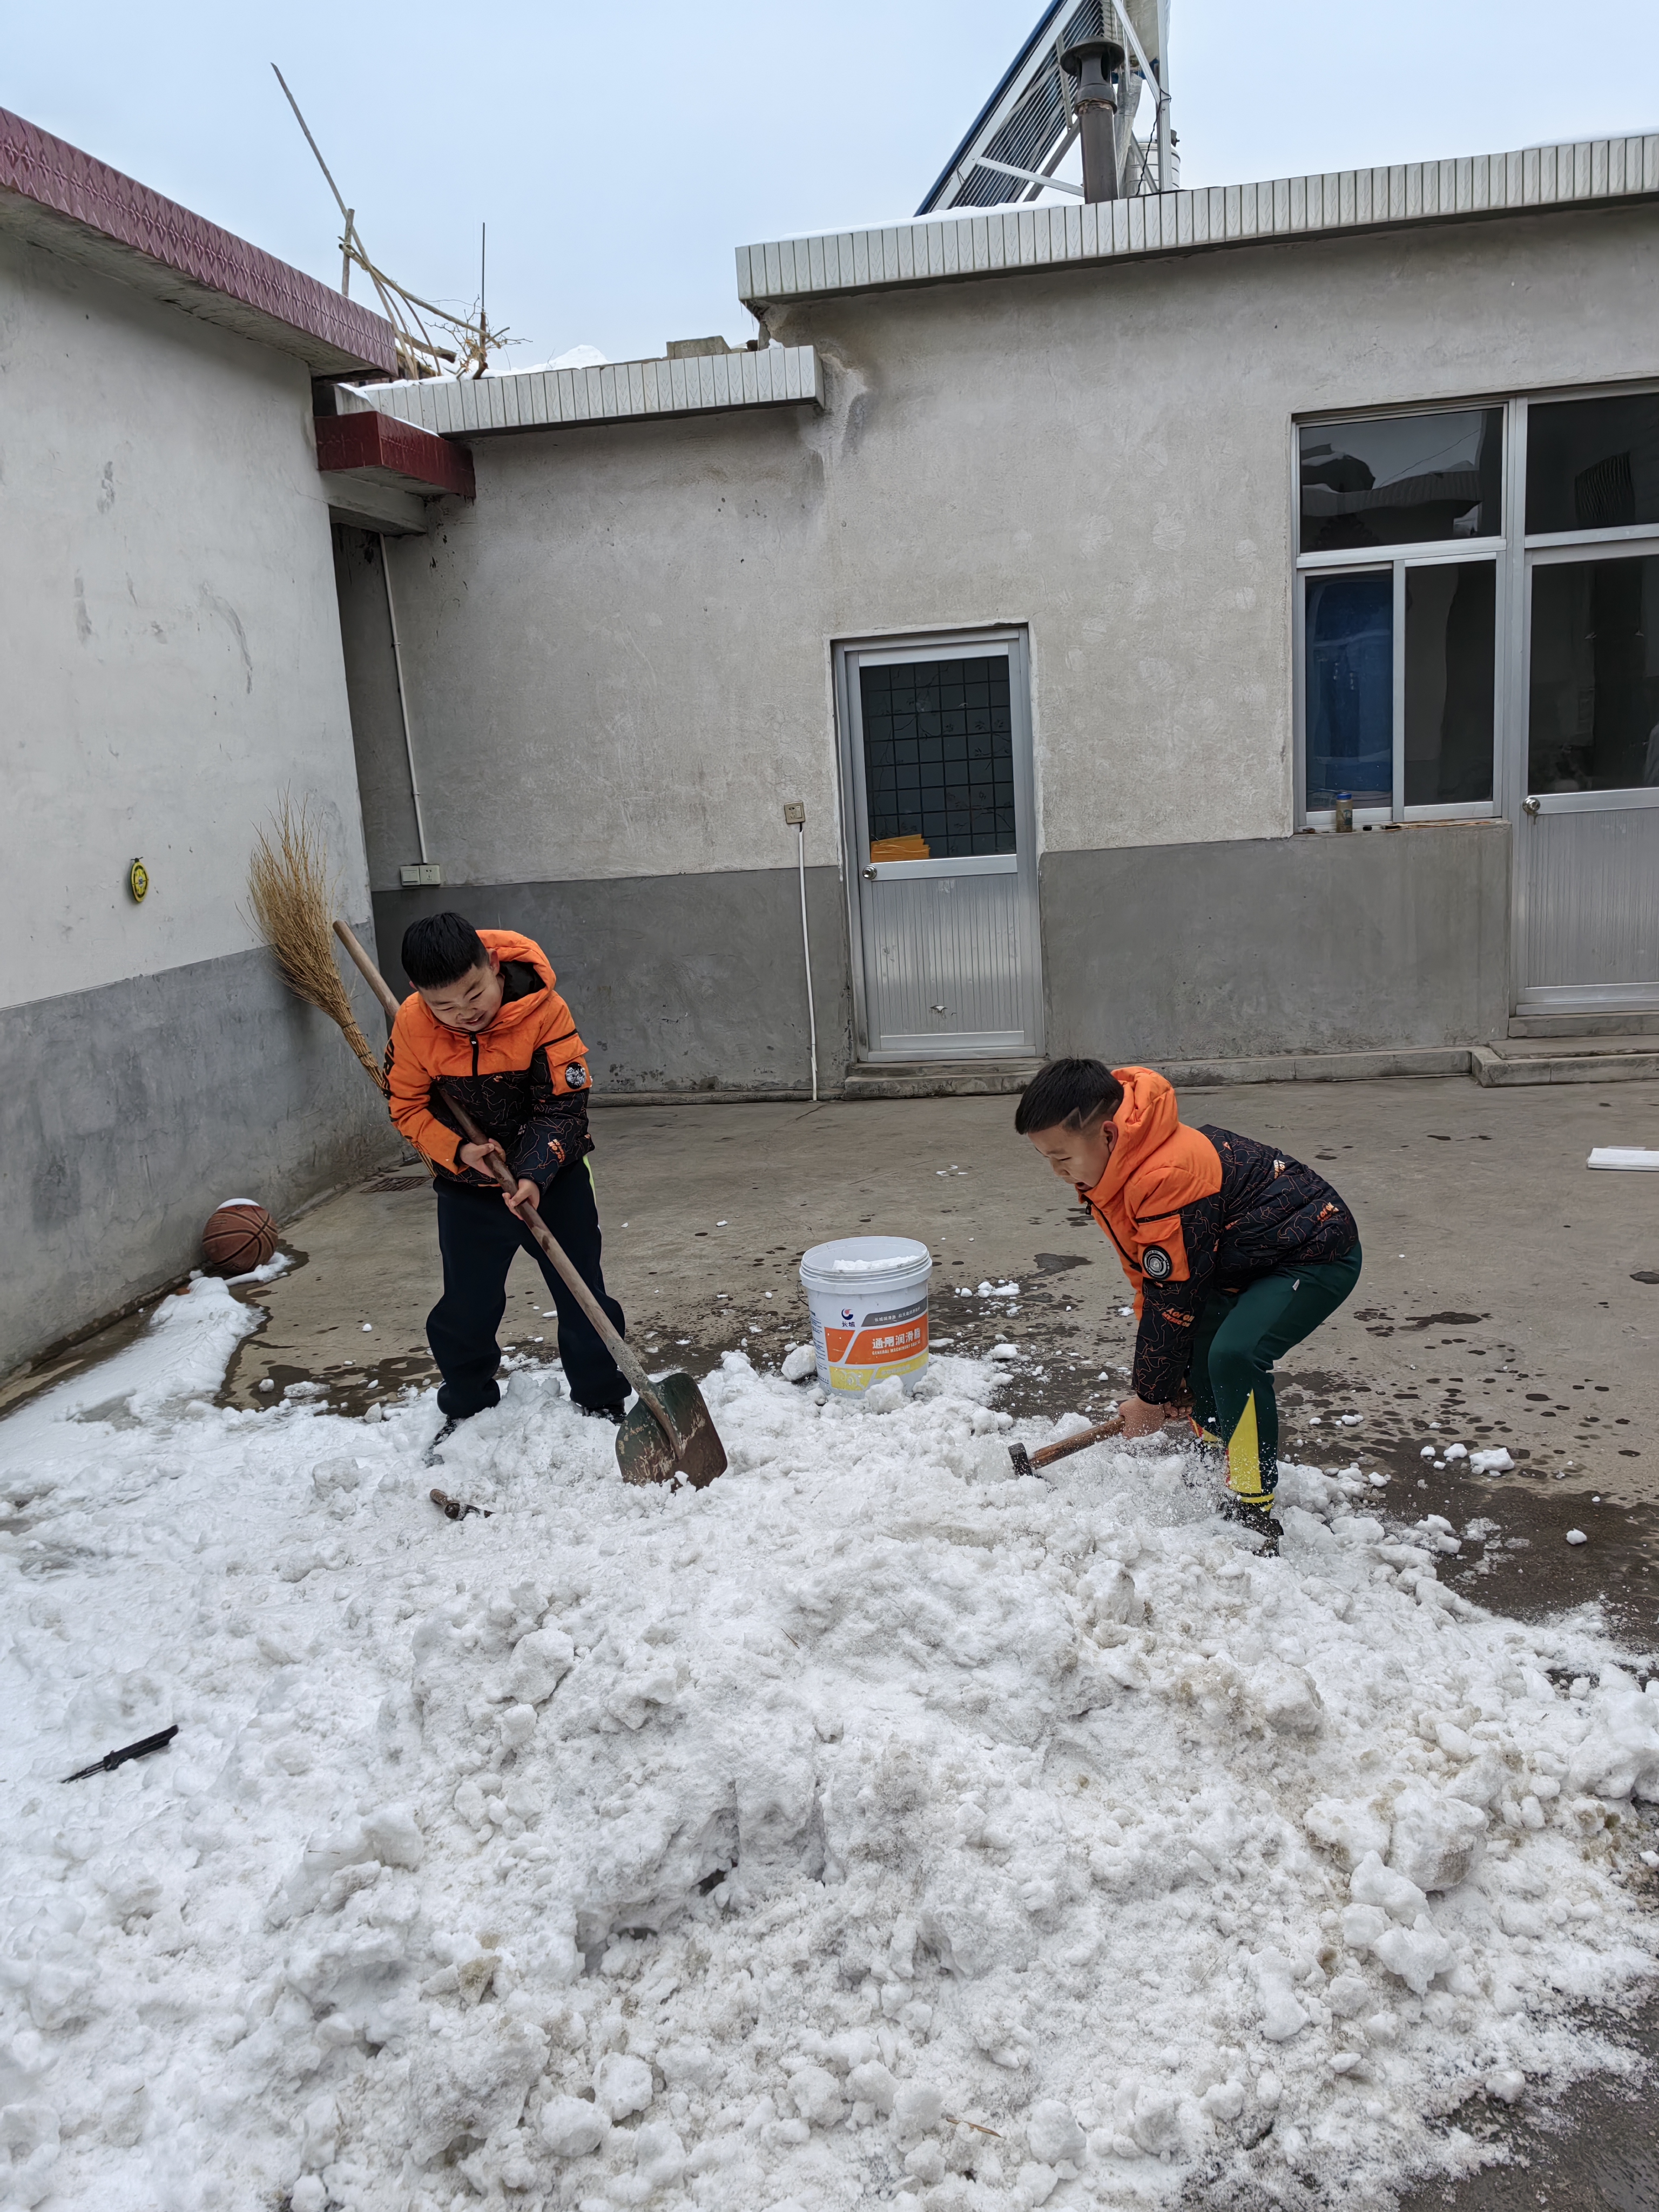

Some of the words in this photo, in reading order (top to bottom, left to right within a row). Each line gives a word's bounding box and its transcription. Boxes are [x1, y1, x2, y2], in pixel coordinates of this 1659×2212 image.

[1166, 1307, 1185, 1318] JOY
[872, 1327, 921, 1349] 通用润滑脂
